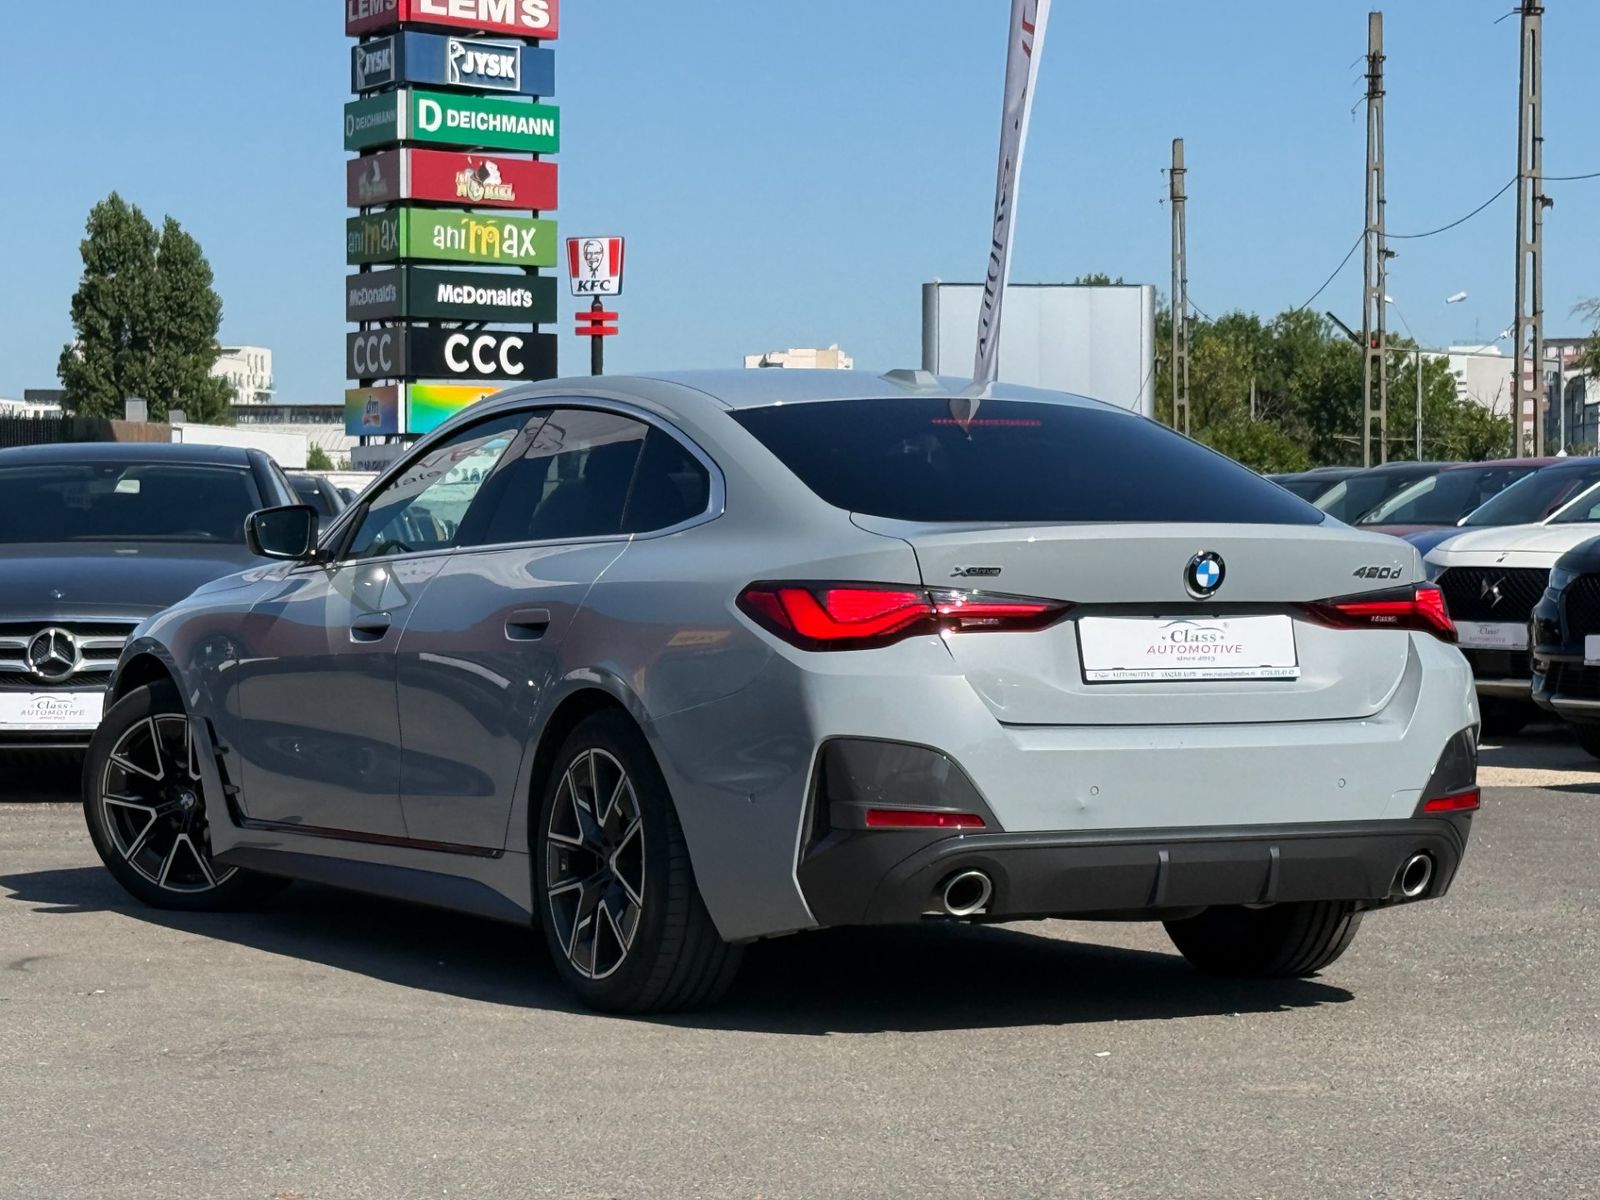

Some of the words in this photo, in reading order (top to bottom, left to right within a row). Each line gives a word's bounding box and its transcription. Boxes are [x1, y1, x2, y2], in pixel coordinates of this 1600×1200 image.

[364, 48, 391, 75] JYSK
[461, 51, 516, 79] JYSK
[355, 109, 396, 131] DEICHMANN
[446, 108, 555, 137] DEICHMANN
[347, 218, 399, 256] animax
[432, 217, 537, 258] animax
[348, 283, 397, 306] McDonald's
[436, 283, 533, 308] McDonald's
[576, 279, 612, 293] KFC
[352, 333, 392, 375] CCC
[444, 333, 525, 376] CCC
[1352, 565, 1403, 580] 420d
[1170, 628, 1218, 644] Class
[1146, 643, 1244, 655] AUTOMOTIVE
[20, 708, 86, 717] AUTOMOTIVE
[37, 700, 68, 710] Class
